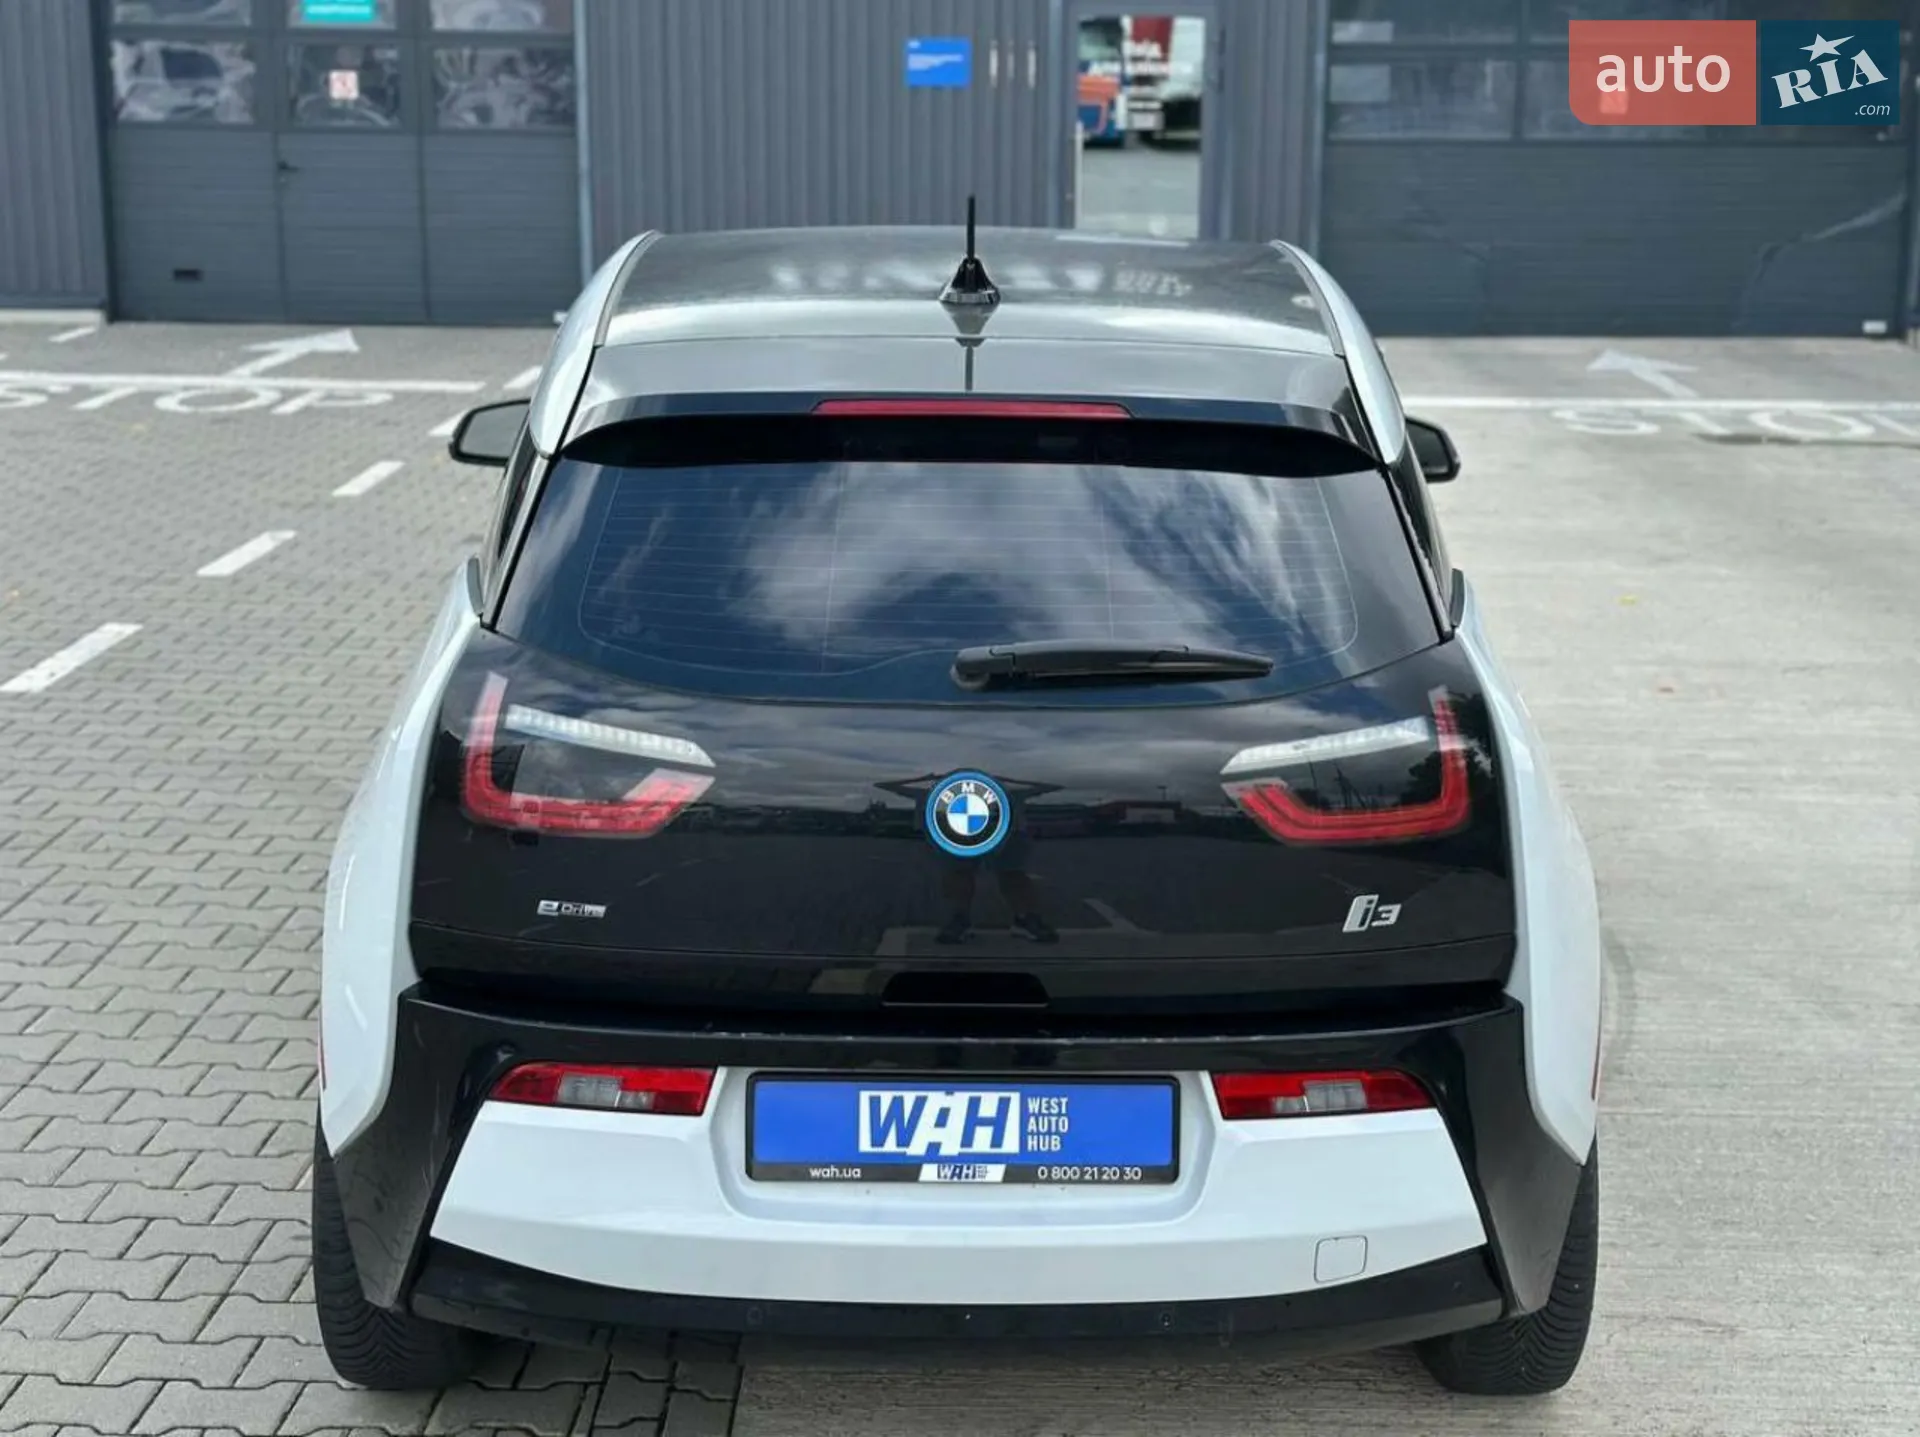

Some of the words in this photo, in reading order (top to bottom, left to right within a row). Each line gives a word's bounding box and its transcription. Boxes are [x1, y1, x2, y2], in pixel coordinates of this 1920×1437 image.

[940, 782, 997, 805] BMW
[1342, 894, 1402, 933] i3
[1027, 1097, 1068, 1115] WEST
[868, 1093, 1012, 1156] WAH
[1027, 1116, 1069, 1133] AUTO
[1027, 1134, 1061, 1152] HUB
[809, 1165, 861, 1178] wah.ua
[1037, 1166, 1048, 1180] 0
[1051, 1166, 1080, 1180] 800
[1083, 1166, 1099, 1180] 21
[1101, 1166, 1120, 1180] 20
[1123, 1166, 1142, 1180] 30
